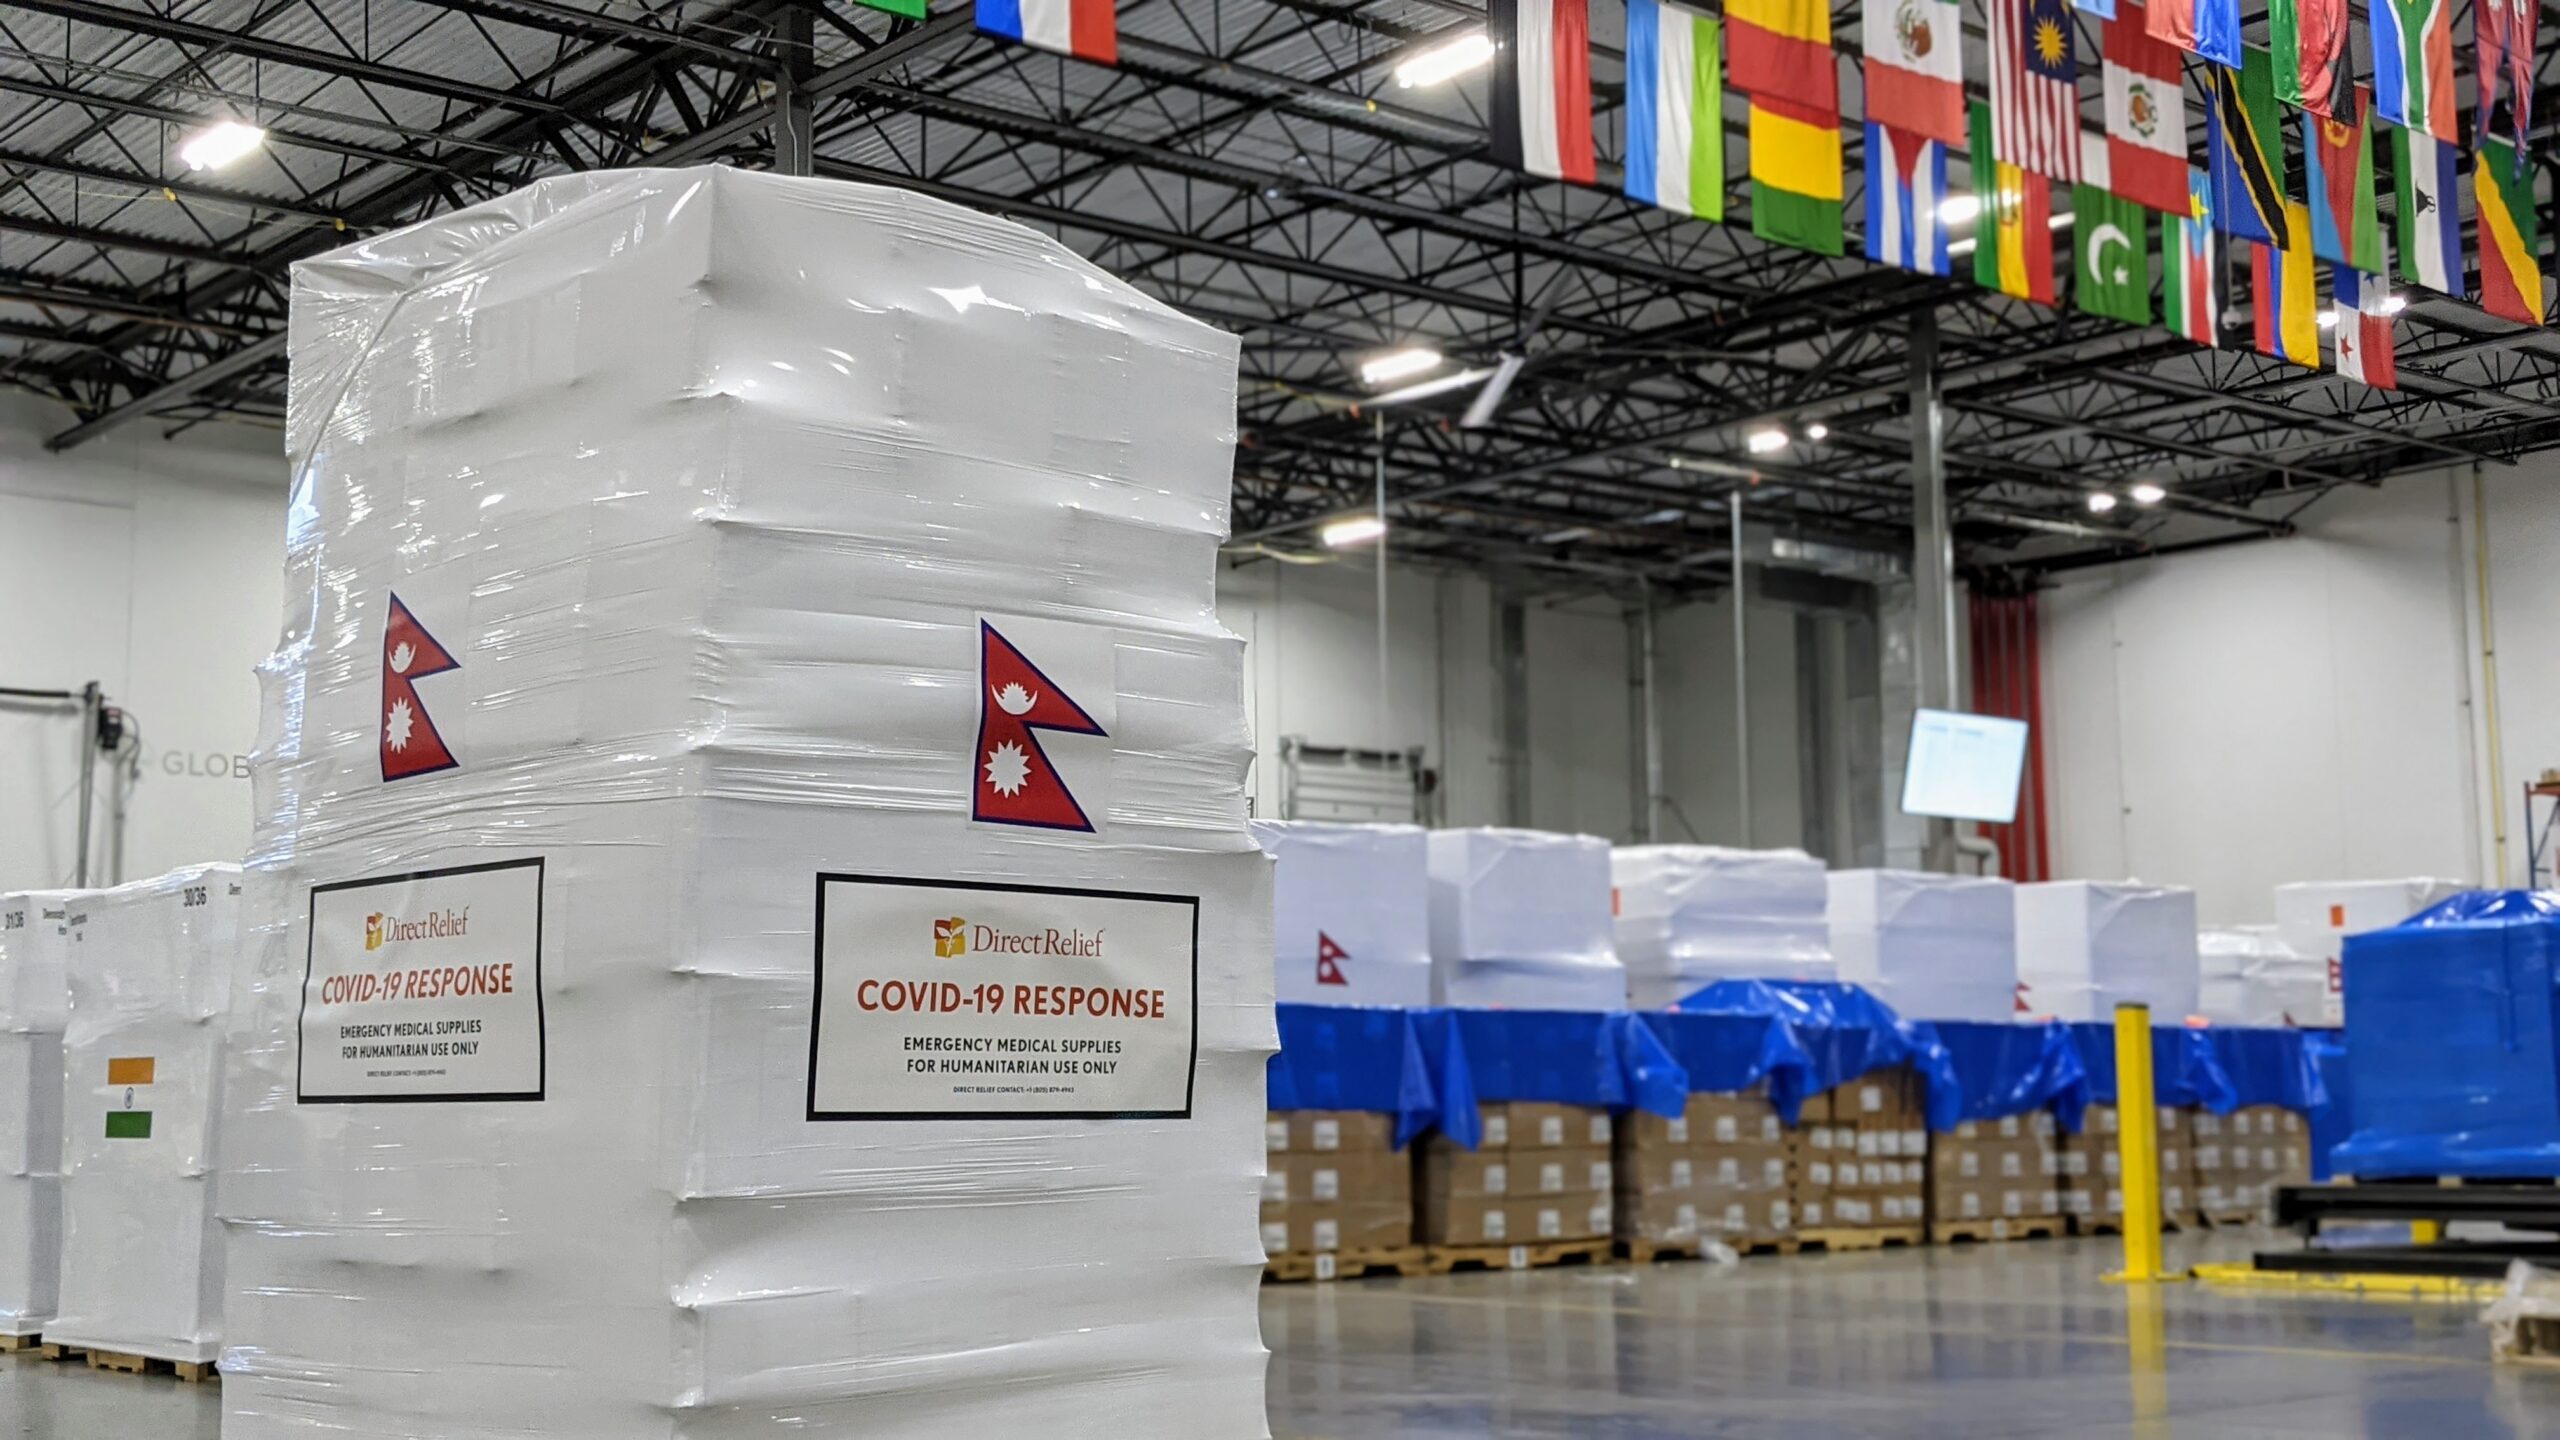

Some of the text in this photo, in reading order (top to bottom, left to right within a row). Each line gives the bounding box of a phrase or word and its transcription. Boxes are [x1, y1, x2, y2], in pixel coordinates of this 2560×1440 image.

[322, 963, 513, 1005] COVID-19 RESPONSE
[857, 979, 1166, 1018] COVID-19 RESPONSE
[340, 1019, 482, 1039] EMERGENCY MEDICAL SUPPLIES
[342, 1041, 479, 1059] FOR HUMANITARIAN USE ONLY
[904, 1036, 1122, 1054] EMERGENCY MEDICAL SUPPLIES
[907, 1058, 1117, 1075] FOR HUMANITARIAN USE ONLY
